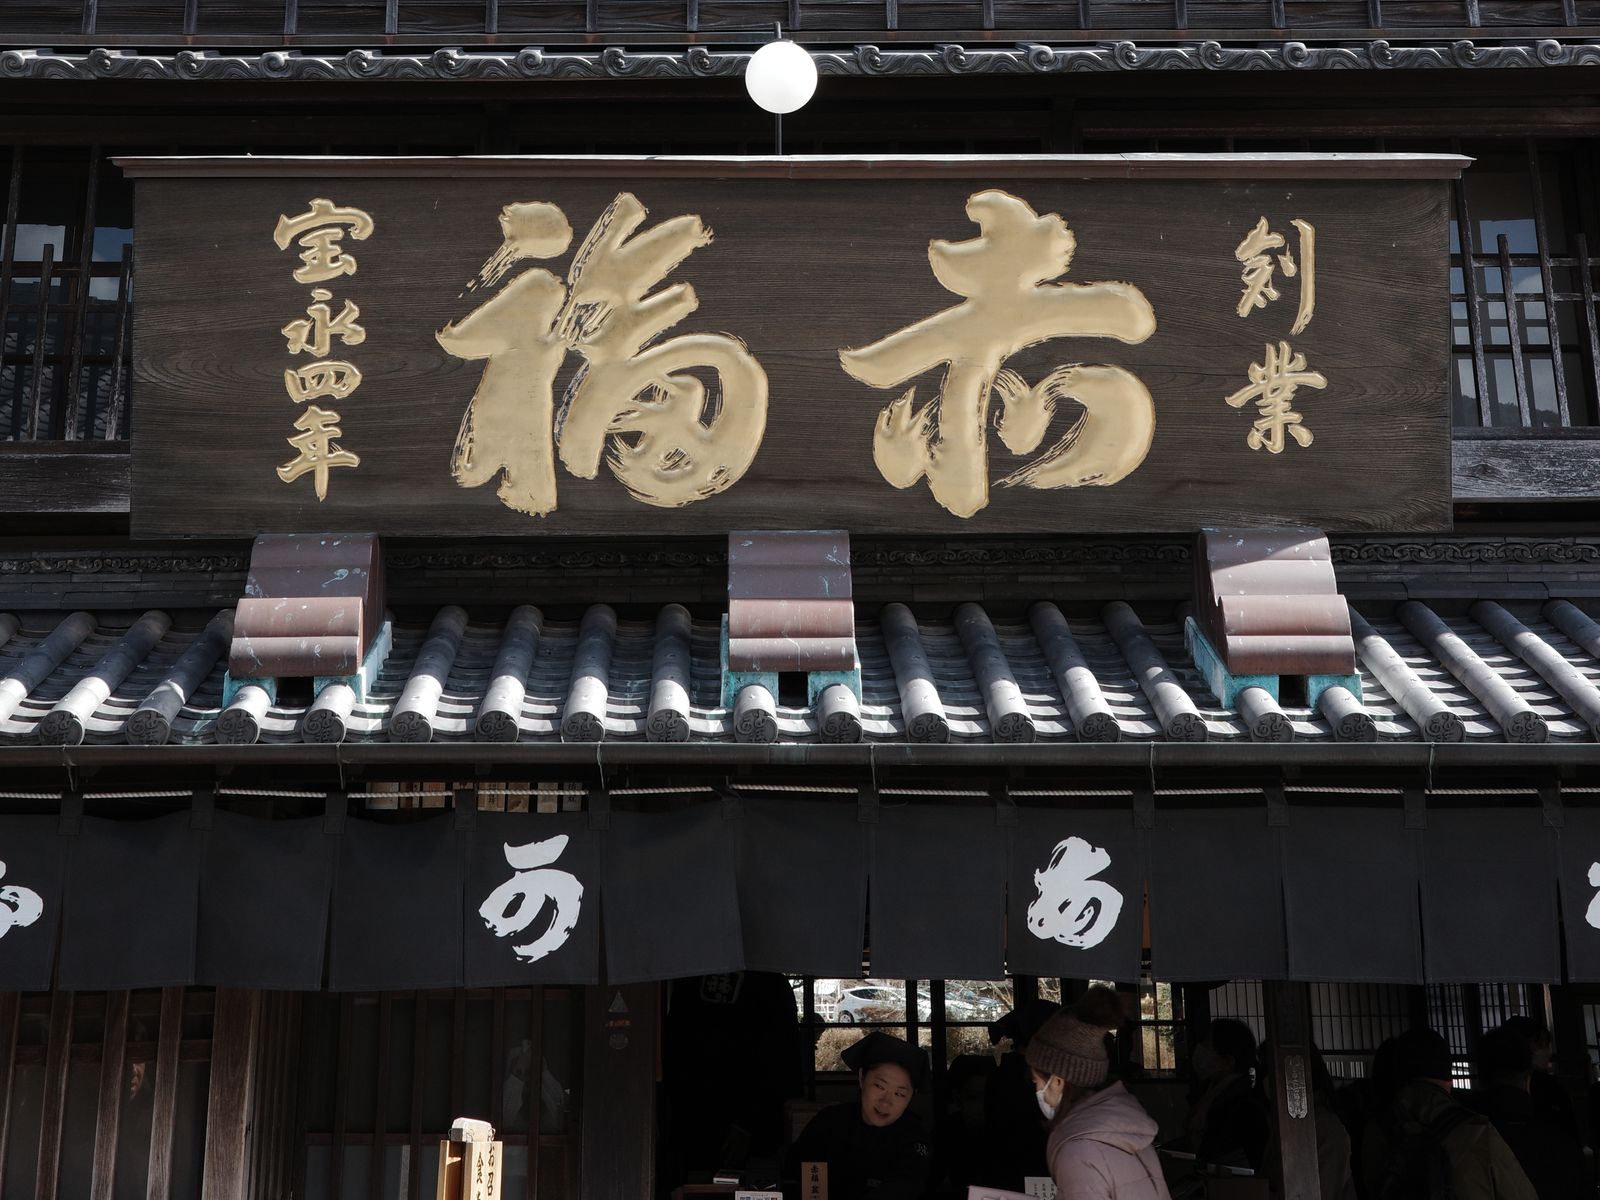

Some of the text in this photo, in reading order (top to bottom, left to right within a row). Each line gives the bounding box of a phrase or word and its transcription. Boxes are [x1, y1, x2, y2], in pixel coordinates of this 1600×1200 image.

[273, 197, 374, 502] 宝永四年
[1225, 216, 1328, 454] 創業
